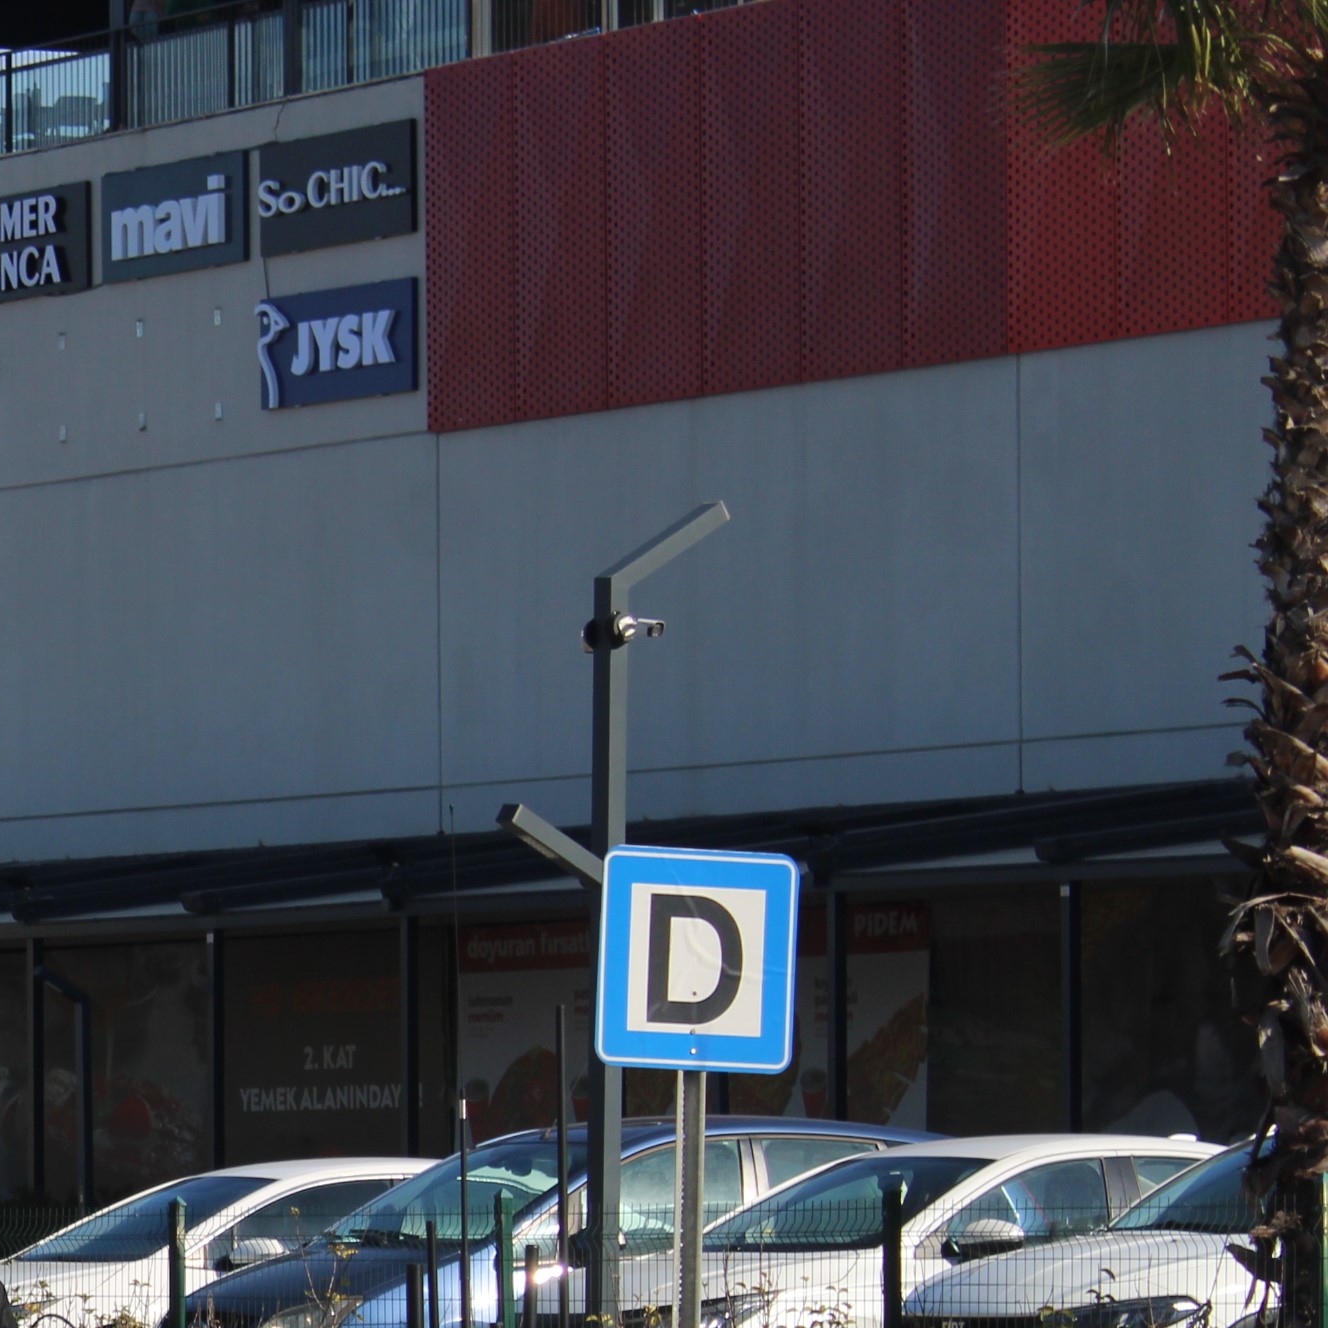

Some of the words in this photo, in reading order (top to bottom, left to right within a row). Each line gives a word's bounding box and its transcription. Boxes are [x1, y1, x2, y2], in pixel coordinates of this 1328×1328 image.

[111, 174, 225, 261] mavi
[289, 309, 396, 375] JYSK
[467, 936, 535, 964] doyuran
[646, 893, 744, 1025] D
[304, 1046, 320, 1070] 2.
[323, 1045, 357, 1070] KAT
[239, 1086, 297, 1113] YEMEK
